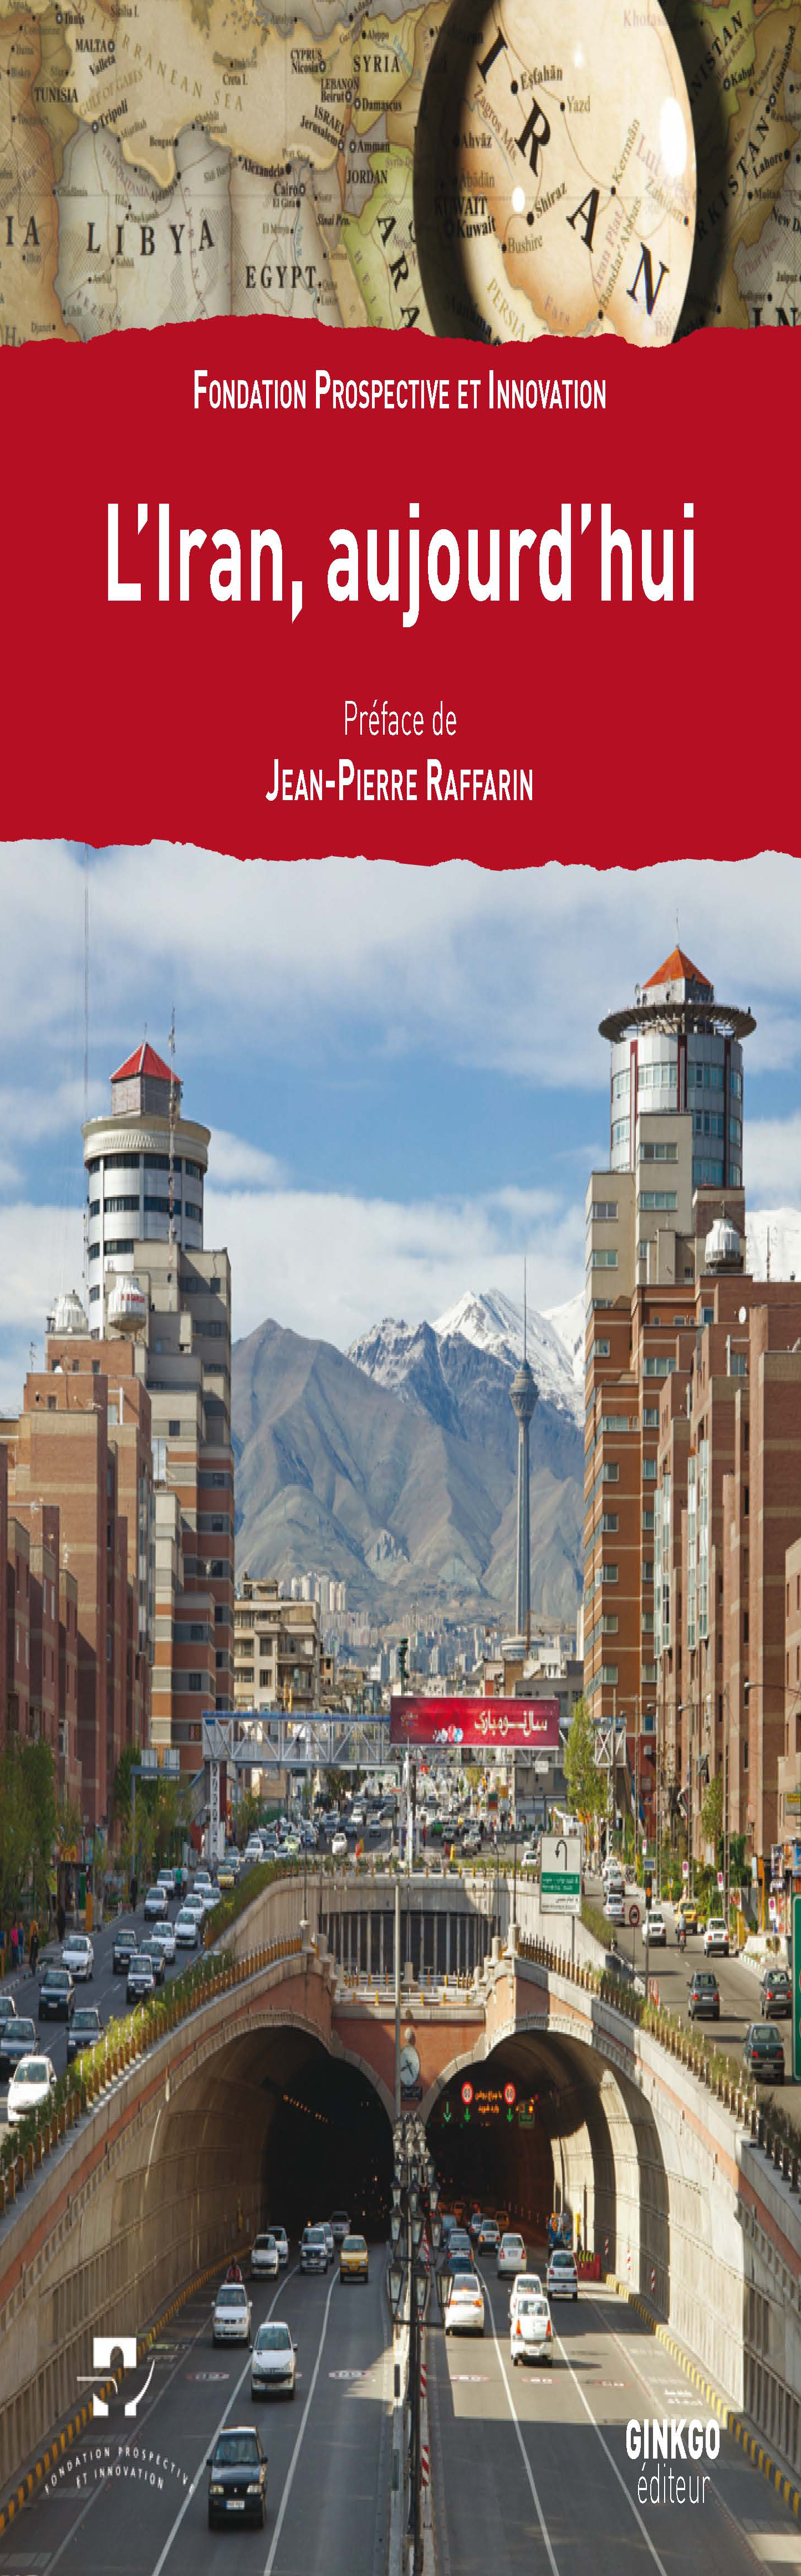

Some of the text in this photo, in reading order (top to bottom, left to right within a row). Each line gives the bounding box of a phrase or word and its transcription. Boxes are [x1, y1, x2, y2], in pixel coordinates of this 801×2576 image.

[75, 38, 108, 53] MALTA
[290, 48, 323, 61] CYPRUS
[353, 54, 400, 73] SYRIA
[321, 78, 359, 90] LEBANON
[34, 87, 78, 103] TUNISIA
[322, 90, 344, 103] Beirut
[567, 95, 590, 113] Yazd
[100, 98, 127, 129] Tripoli
[361, 98, 402, 111] Damascus
[314, 105, 344, 137] ISRAEL
[300, 115, 338, 146] Jerusalem
[358, 140, 390, 152] Amman
[346, 170, 388, 184] JORDAN
[274, 181, 297, 197] Cairo
[435, 196, 487, 216] KUWAIT
[534, 181, 567, 219] Shiraz
[458, 216, 496, 238] Kuwait
[86, 219, 215, 256] LIBYA
[246, 265, 317, 289] EGYPT
